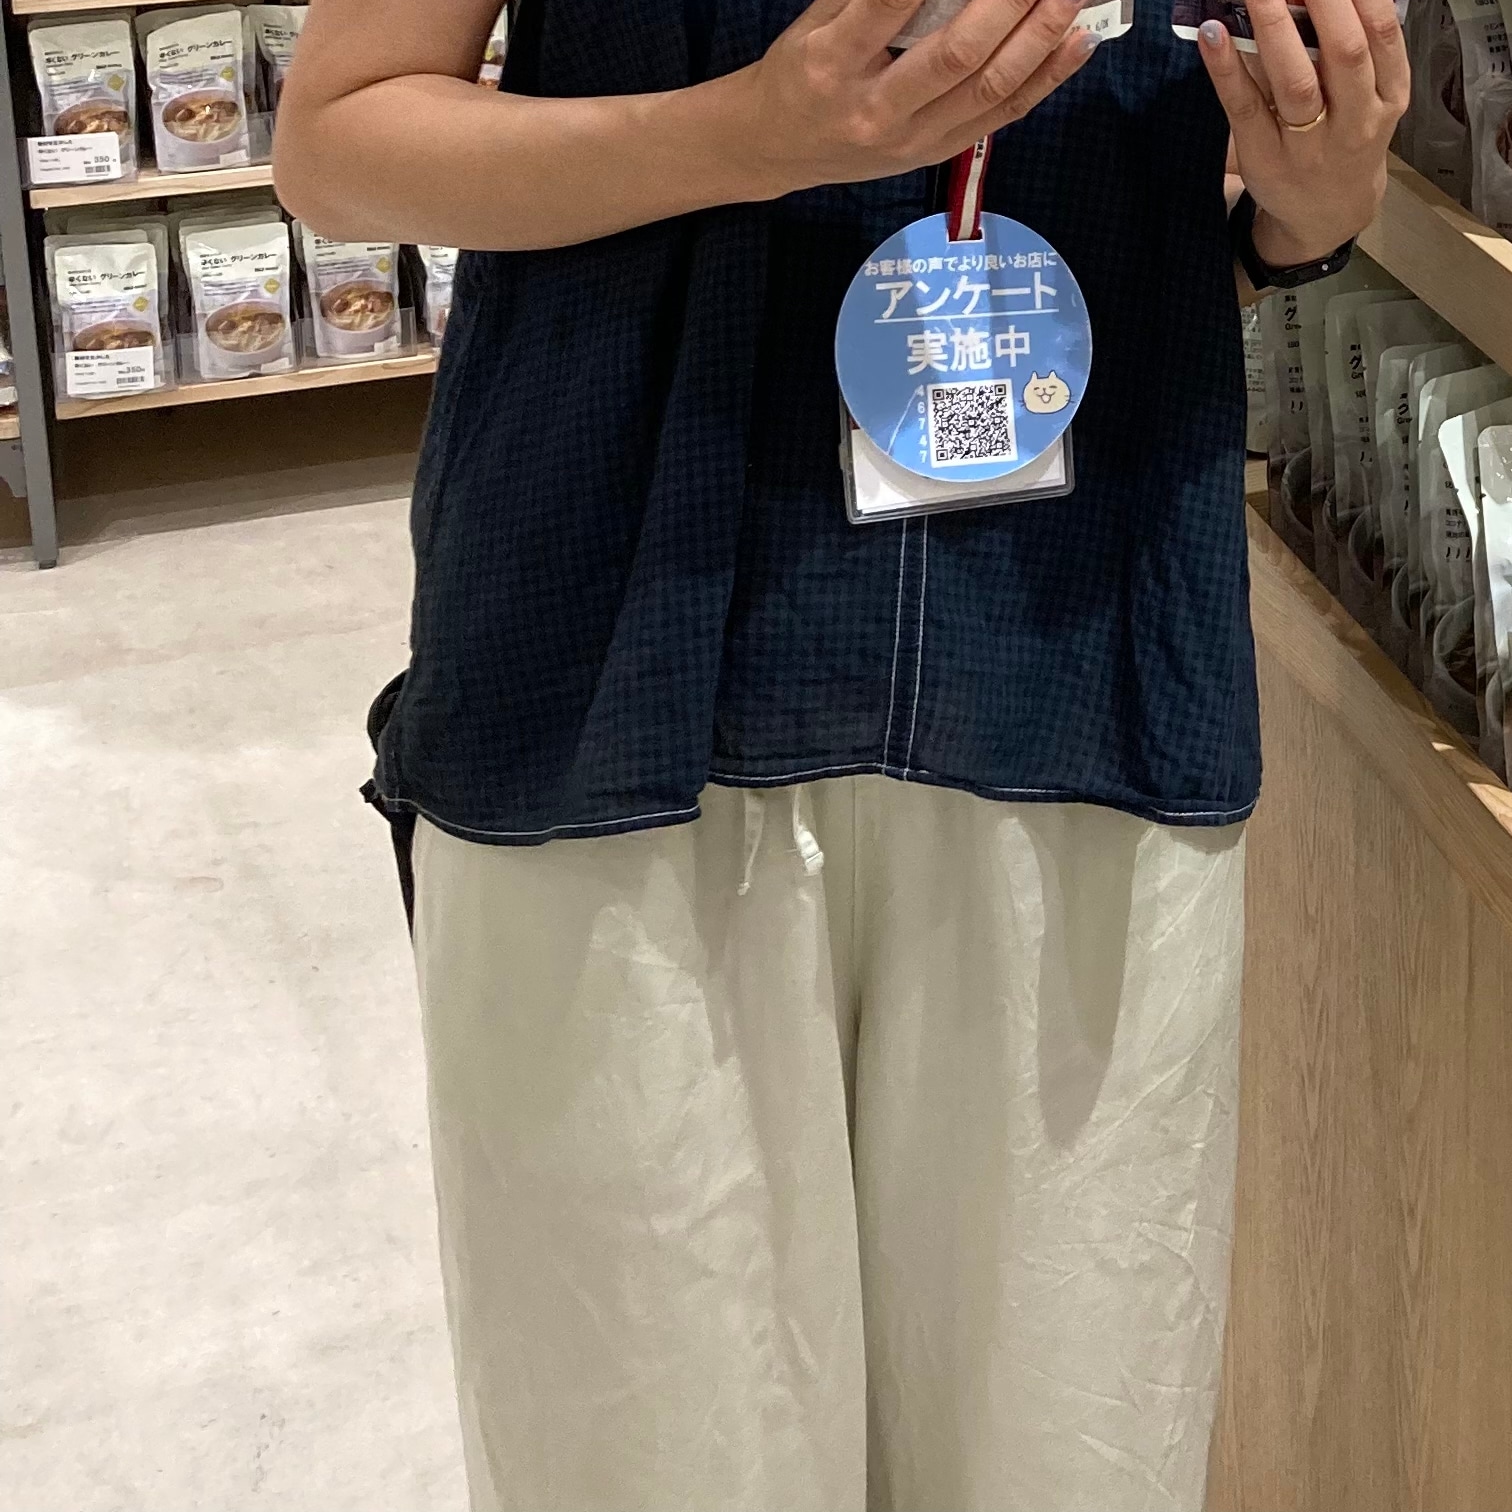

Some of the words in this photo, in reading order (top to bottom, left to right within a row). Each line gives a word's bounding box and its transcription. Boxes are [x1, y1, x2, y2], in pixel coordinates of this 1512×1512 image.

[864, 251, 1057, 276] お客様の声でより良いお店に
[875, 272, 1057, 320] アンケート
[906, 325, 1030, 375] 実施中
